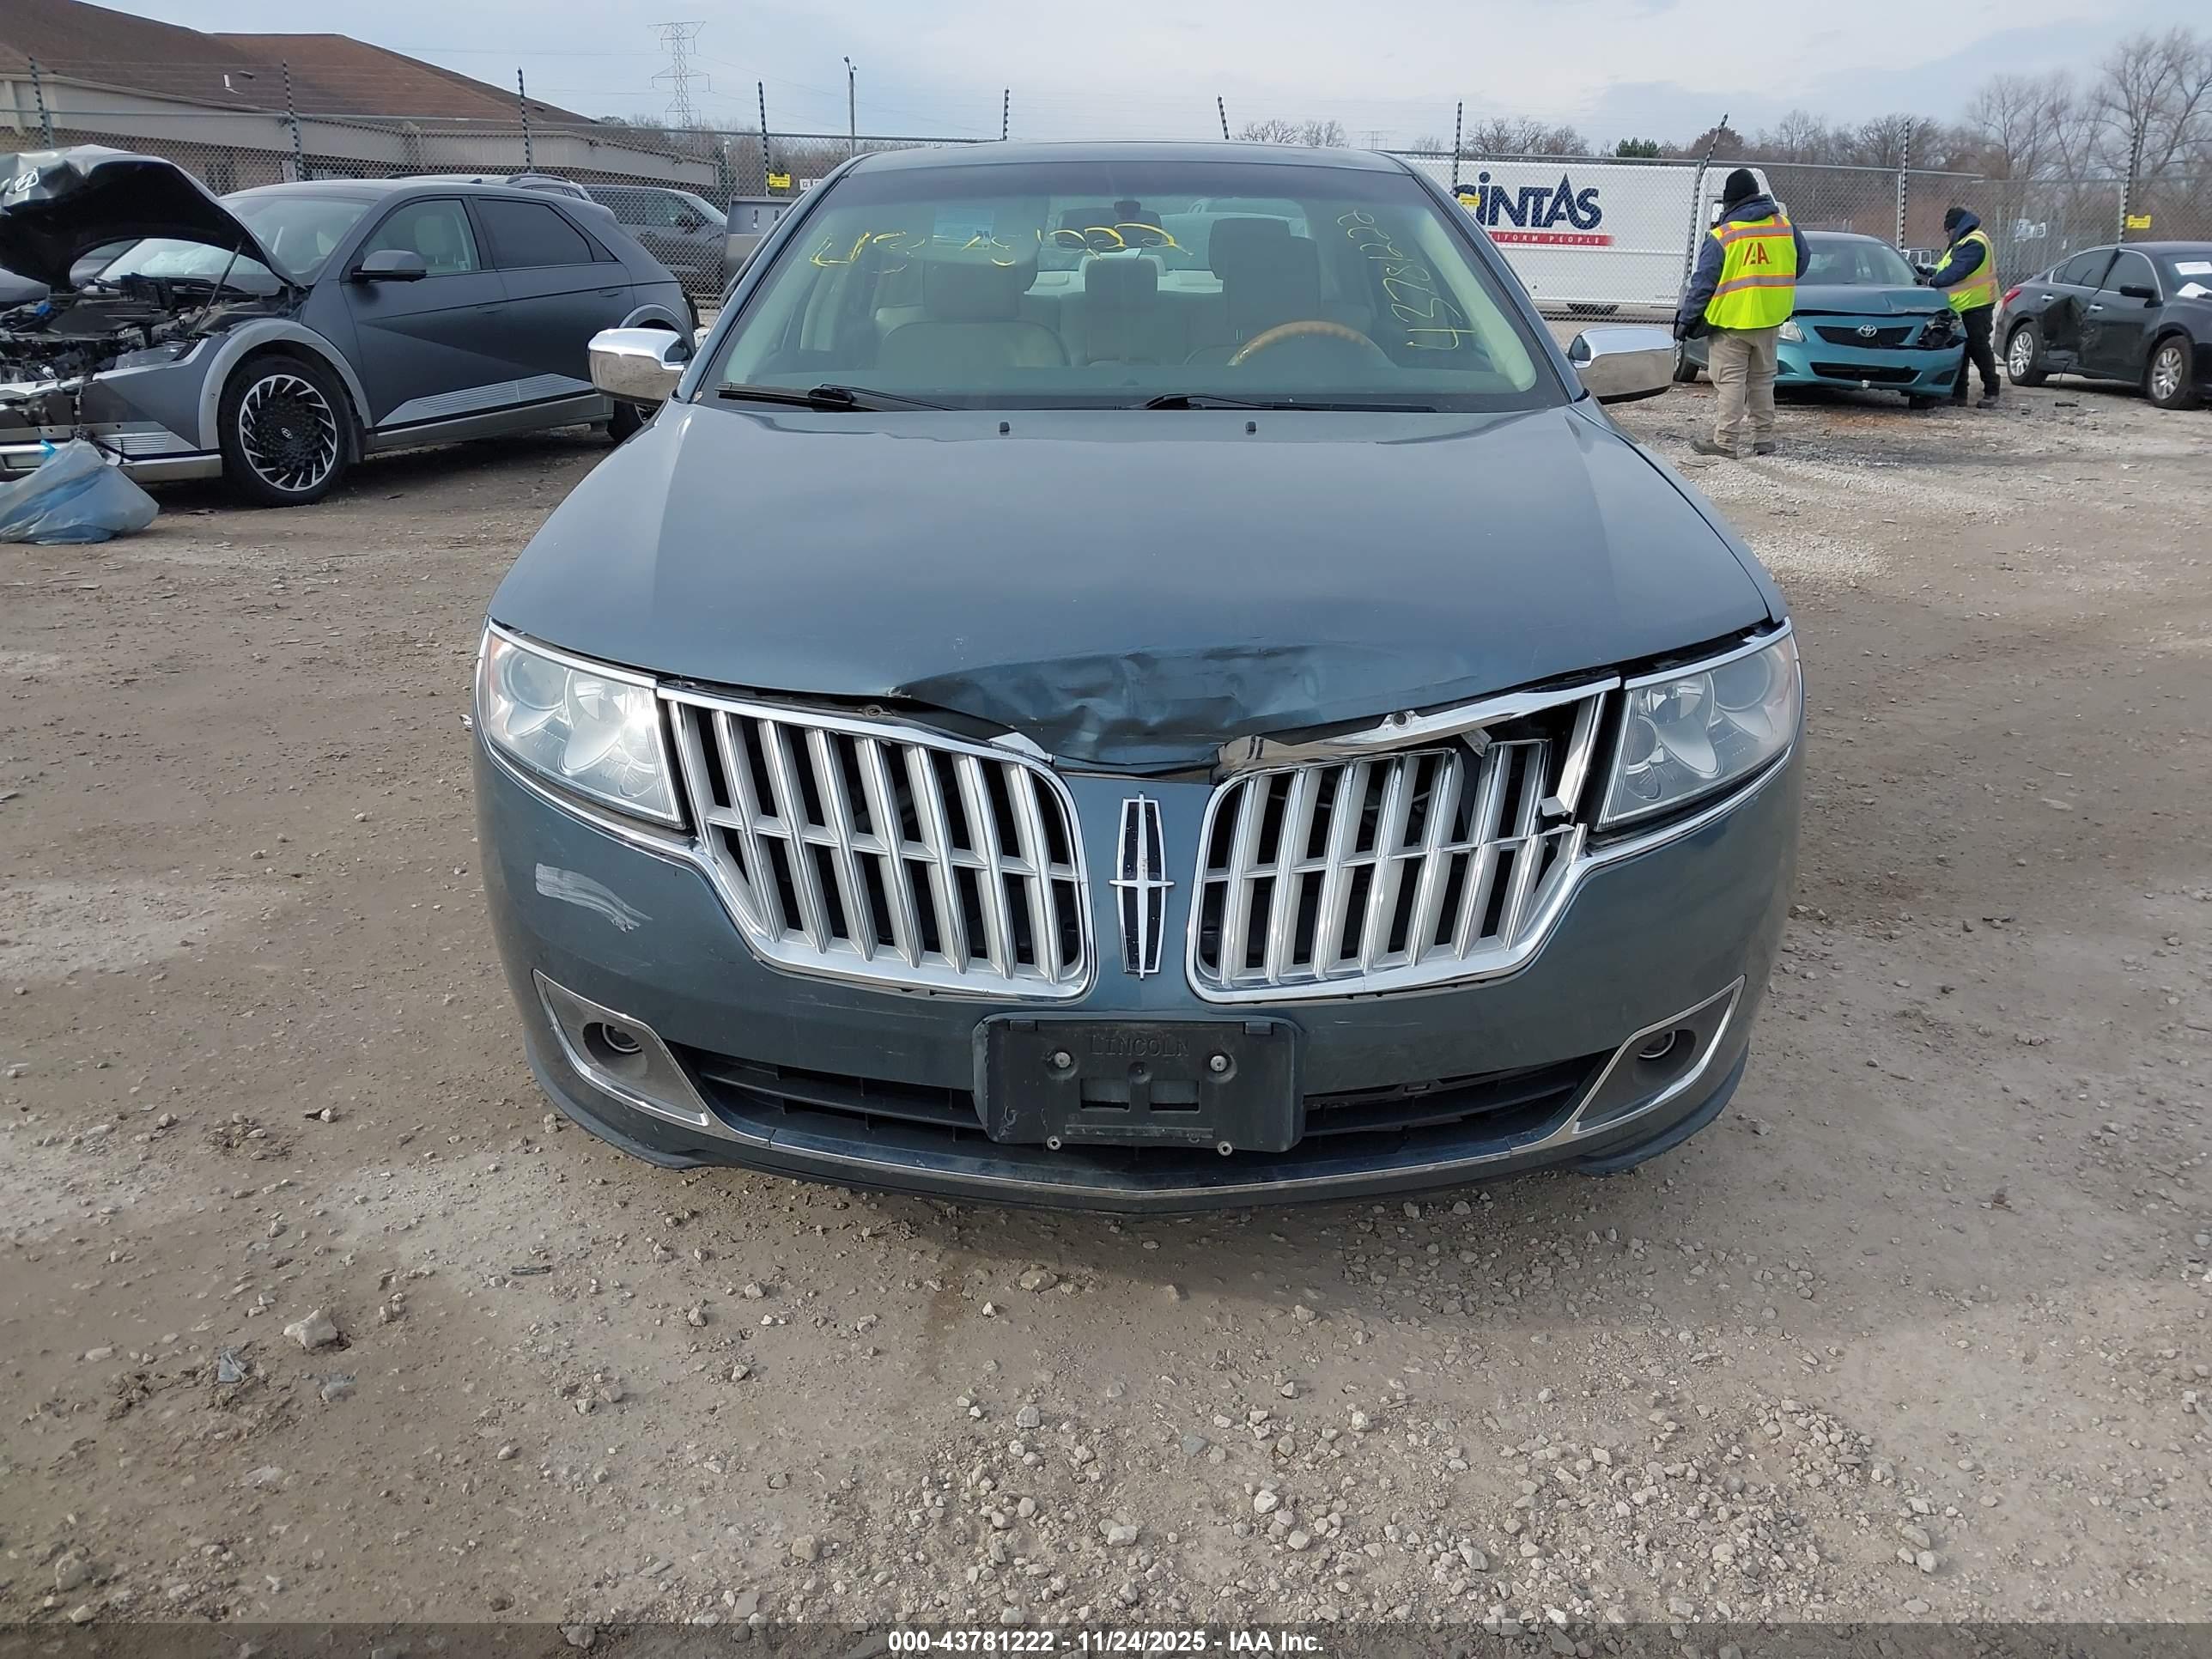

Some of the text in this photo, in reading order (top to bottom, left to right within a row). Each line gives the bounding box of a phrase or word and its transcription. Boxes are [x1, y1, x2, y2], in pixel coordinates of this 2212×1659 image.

[1548, 234, 1601, 244] PEOPLE
[1336, 209, 1476, 350] 43781222
[1091, 1034, 1189, 1058] LINCOLN
